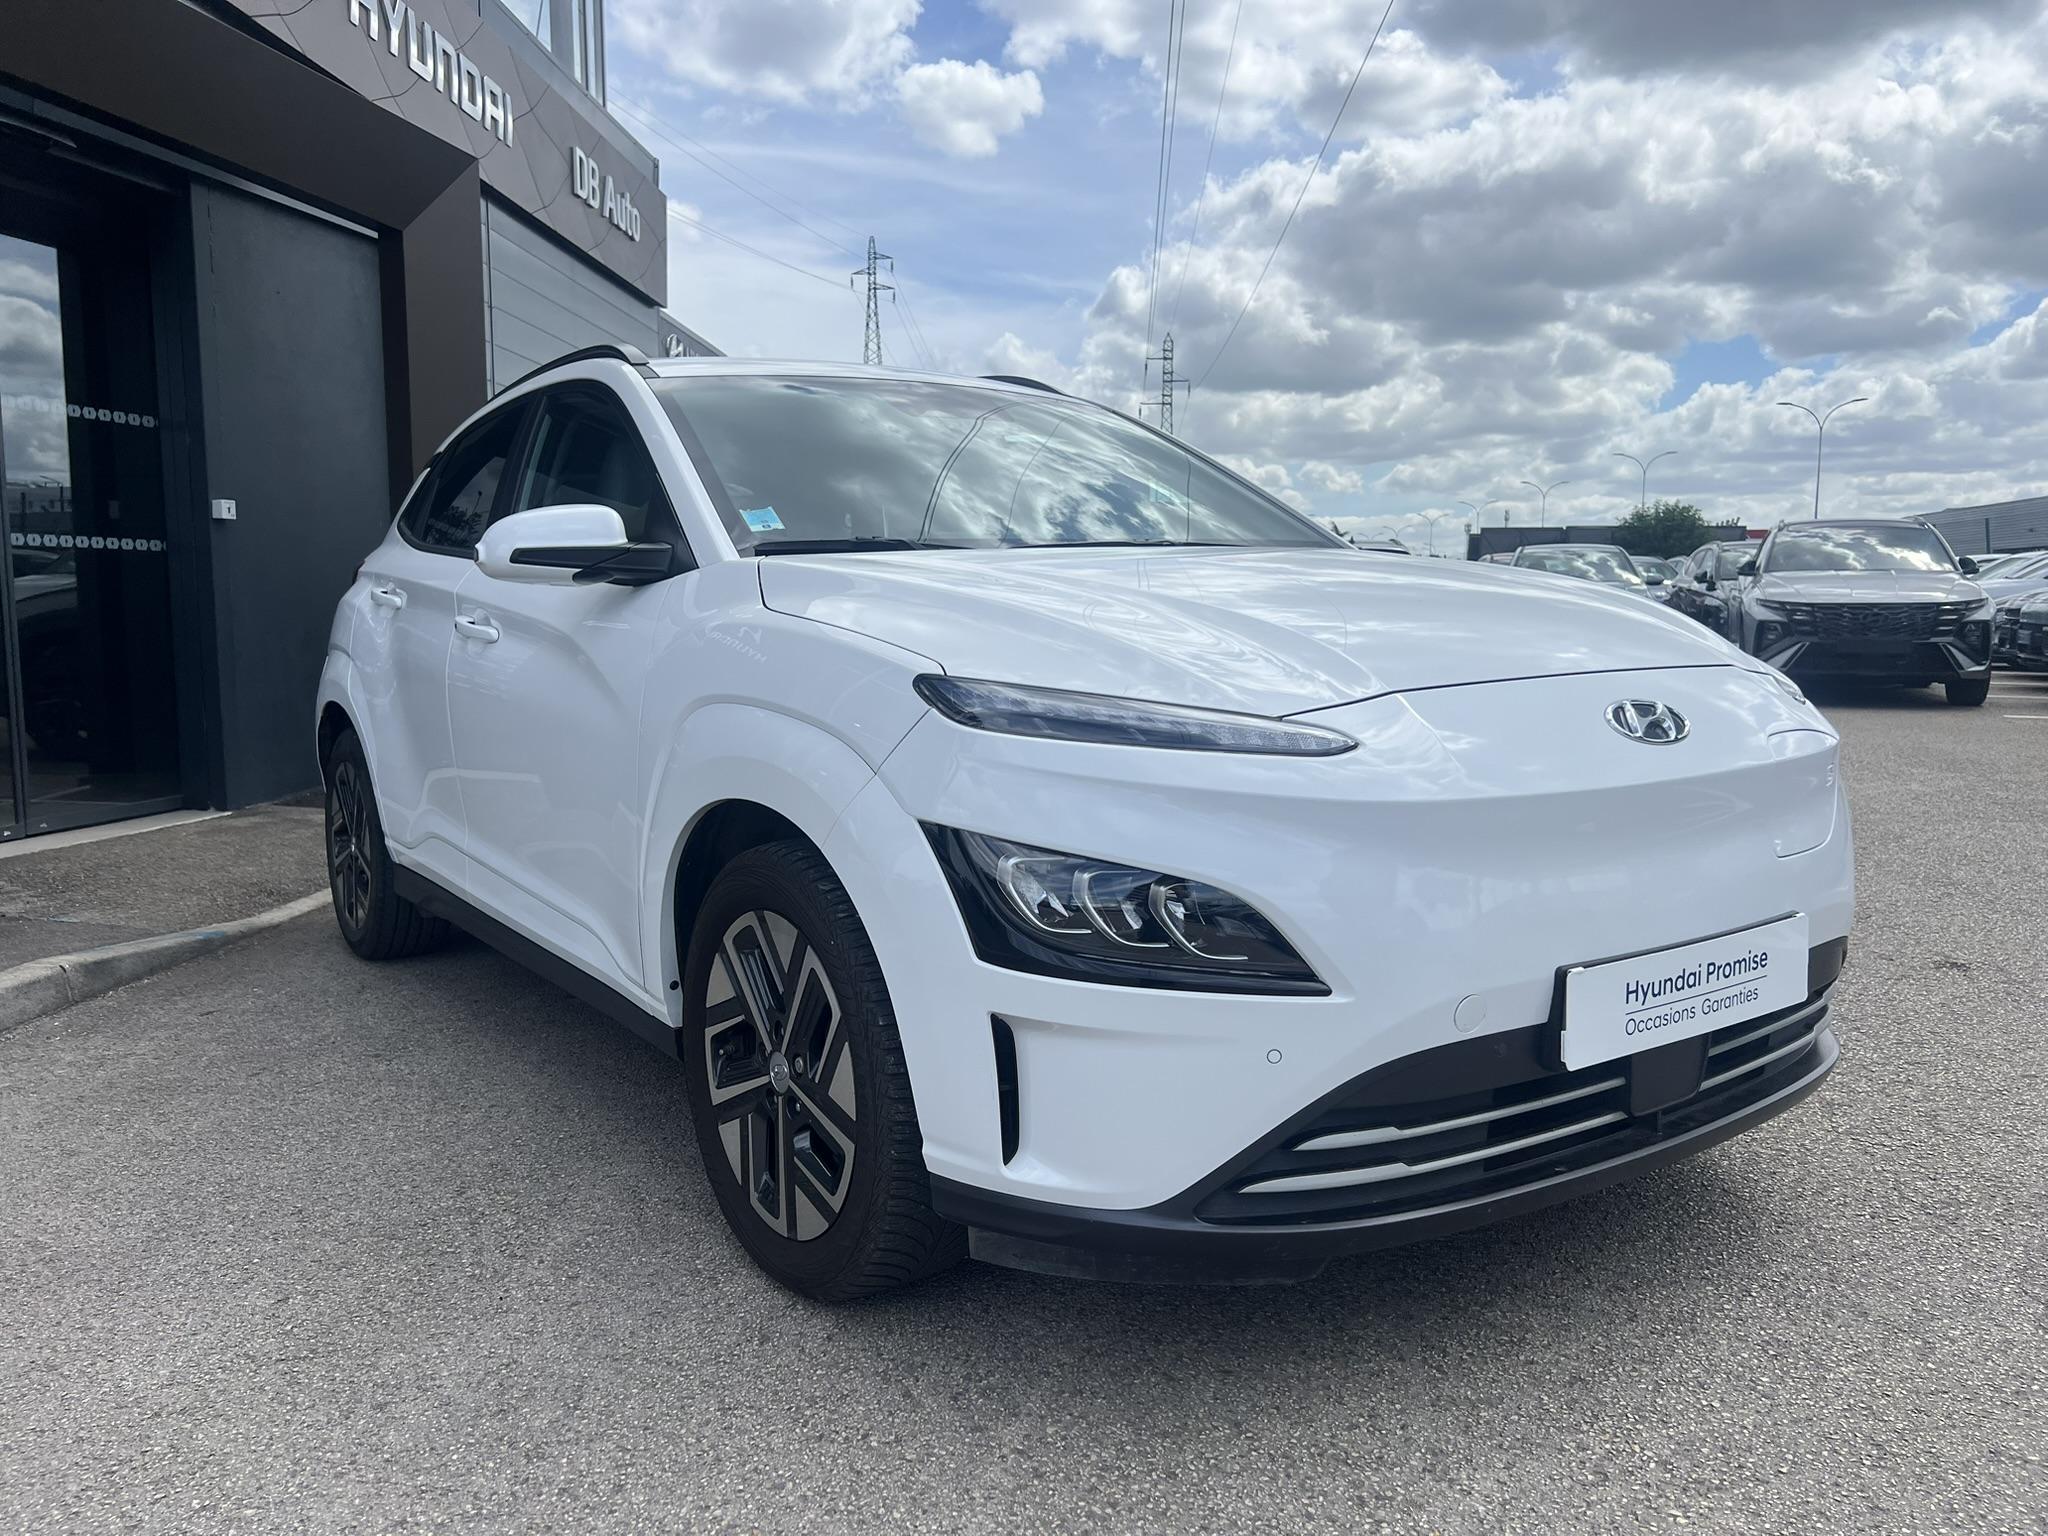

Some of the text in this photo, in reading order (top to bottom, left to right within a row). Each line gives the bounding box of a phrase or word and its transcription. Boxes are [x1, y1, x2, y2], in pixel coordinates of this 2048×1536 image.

[572, 146, 641, 242] DB Auto
[1625, 949, 1768, 1006] Hyundai Promise
[1625, 986, 1759, 1036] Occasions Garanties
